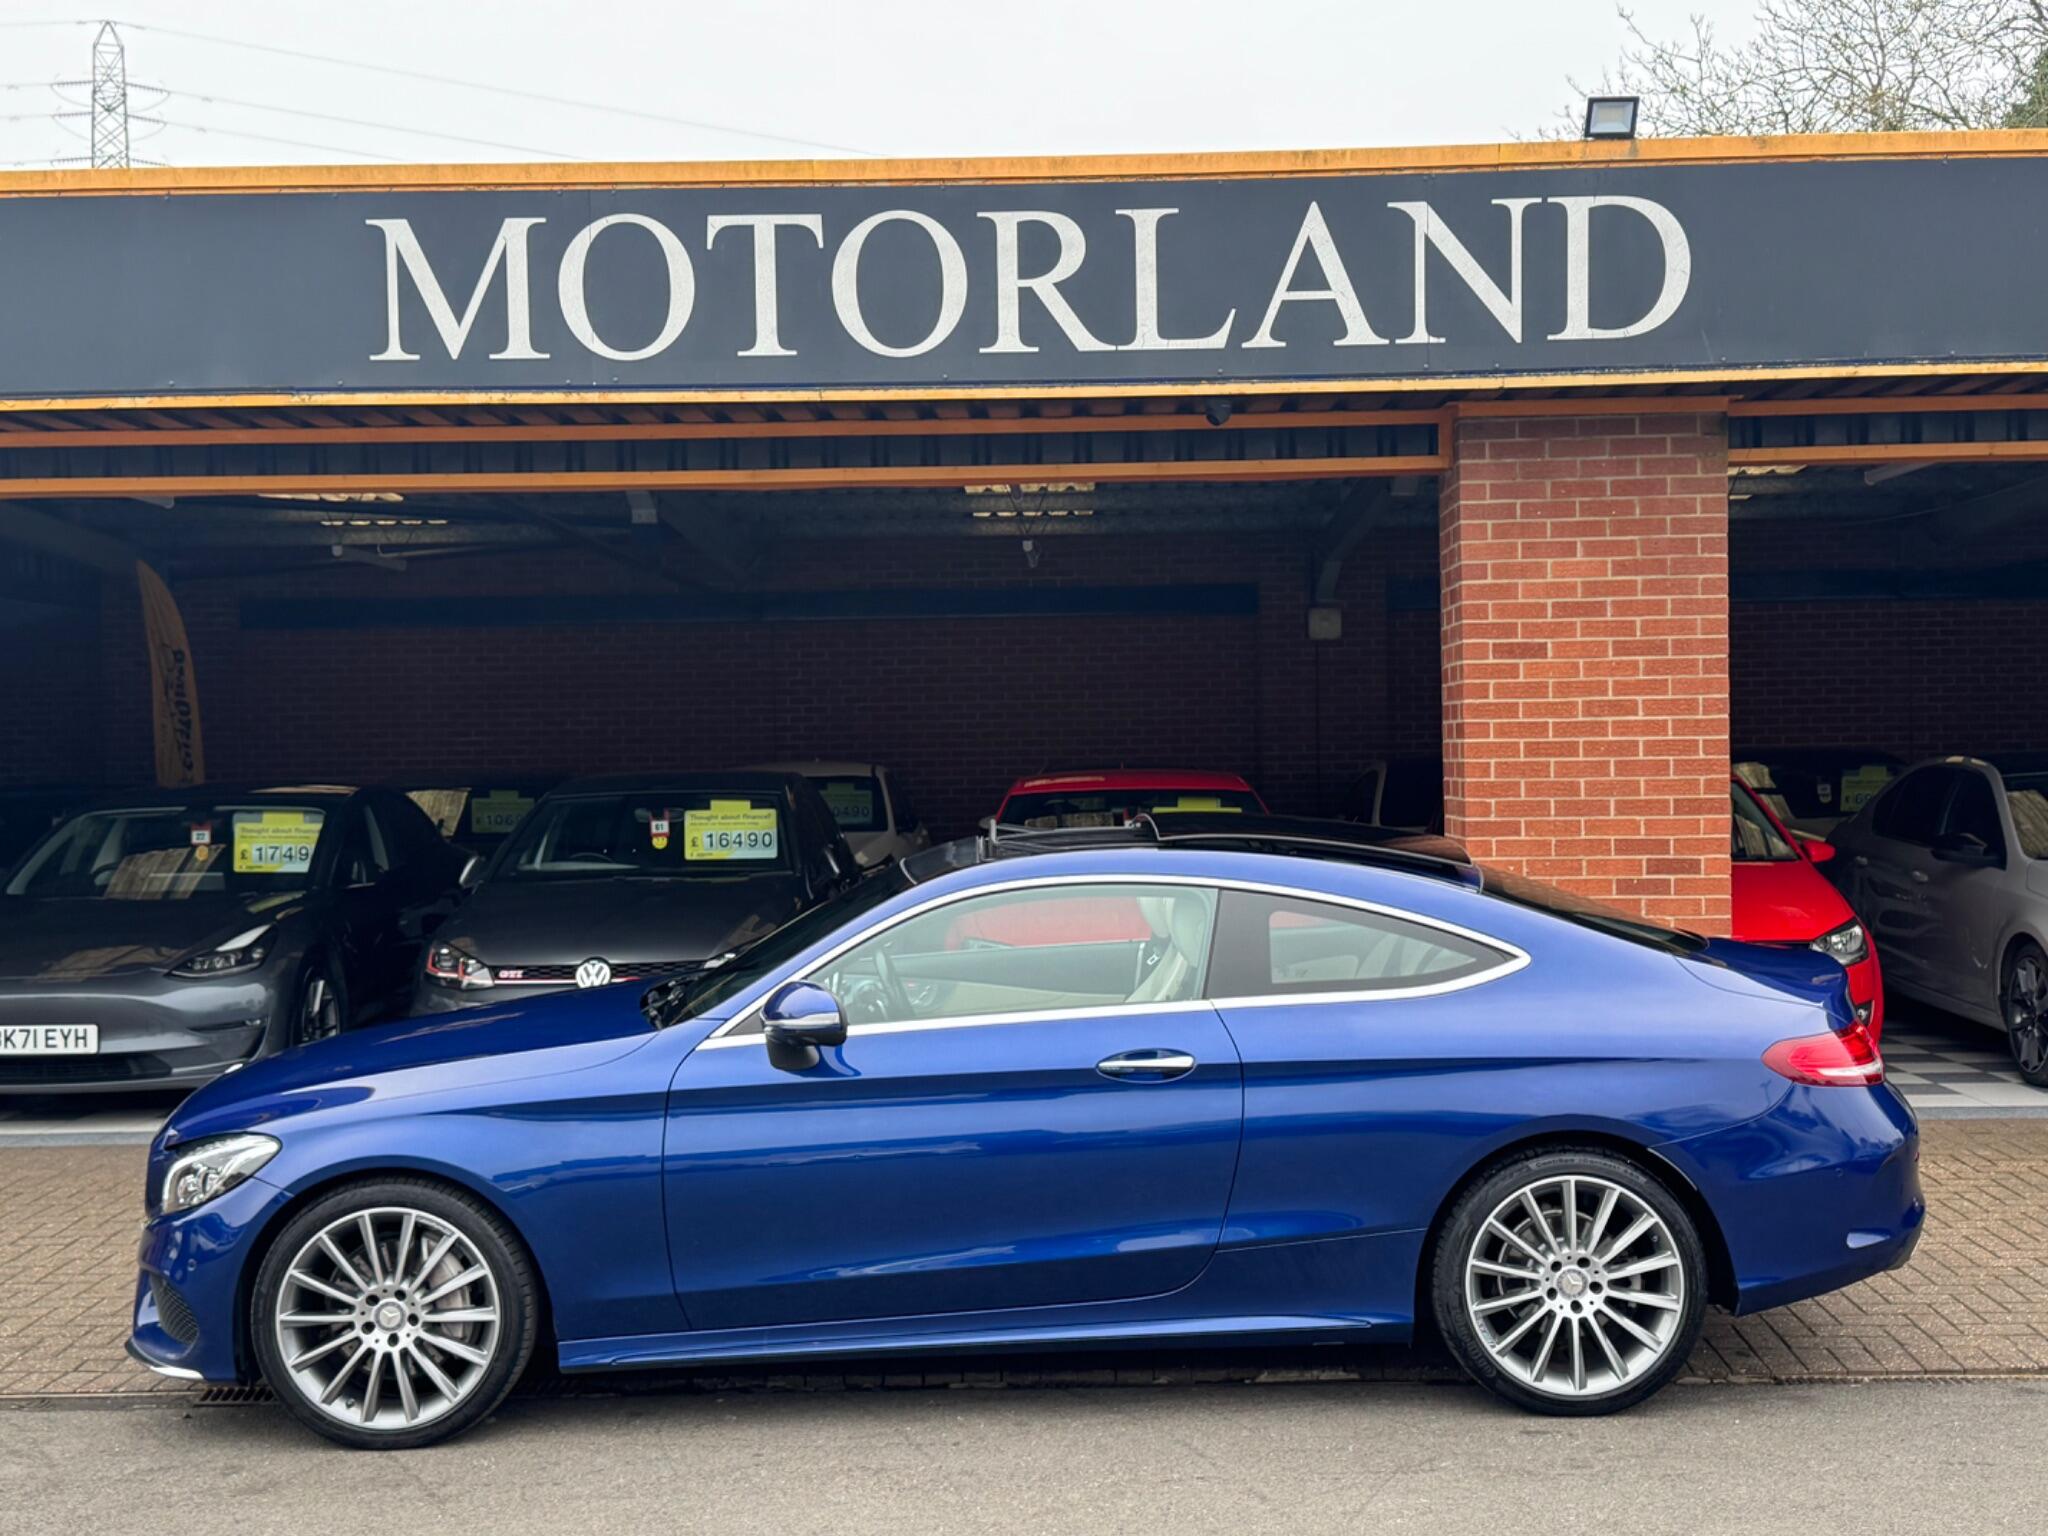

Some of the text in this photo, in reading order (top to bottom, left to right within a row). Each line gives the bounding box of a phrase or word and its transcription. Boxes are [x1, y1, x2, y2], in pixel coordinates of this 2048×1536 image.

[365, 196, 1691, 361] MOTORLAND
[0, 1028, 88, 1049] K71 EYH
